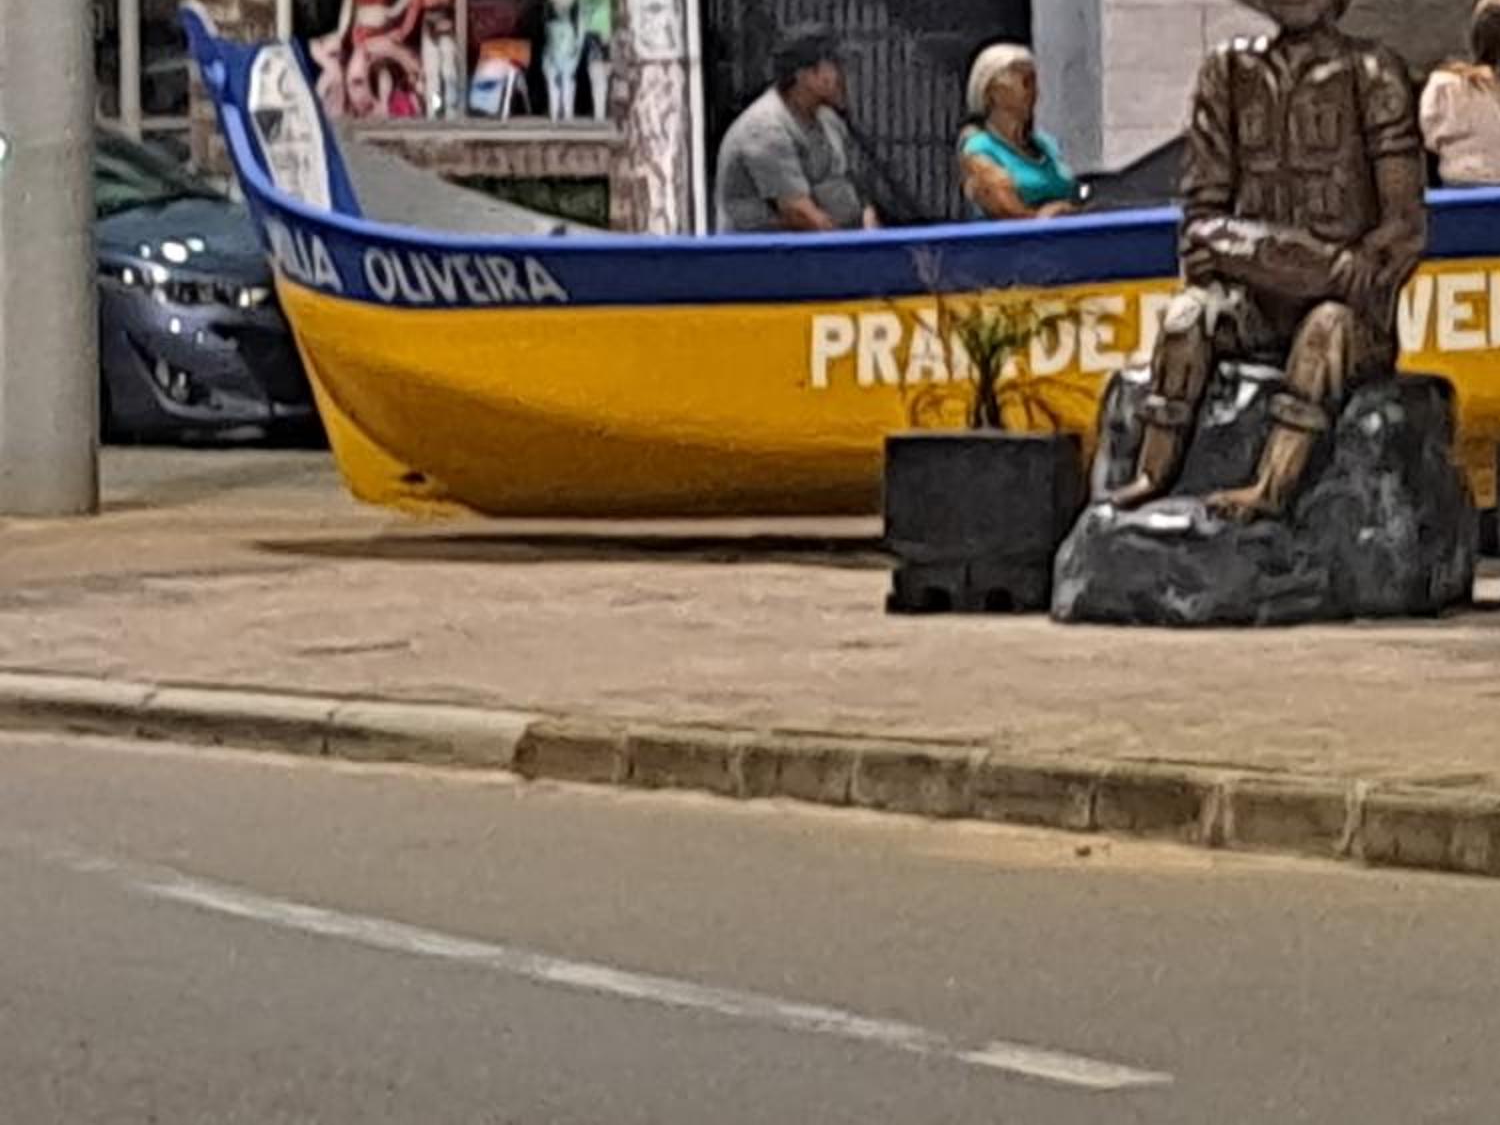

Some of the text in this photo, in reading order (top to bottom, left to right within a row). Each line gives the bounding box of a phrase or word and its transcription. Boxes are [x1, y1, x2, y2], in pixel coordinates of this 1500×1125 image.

[363, 247, 568, 303] OLIVEIRA
[811, 299, 1020, 388] PRAI
[1030, 293, 1126, 375] DE
